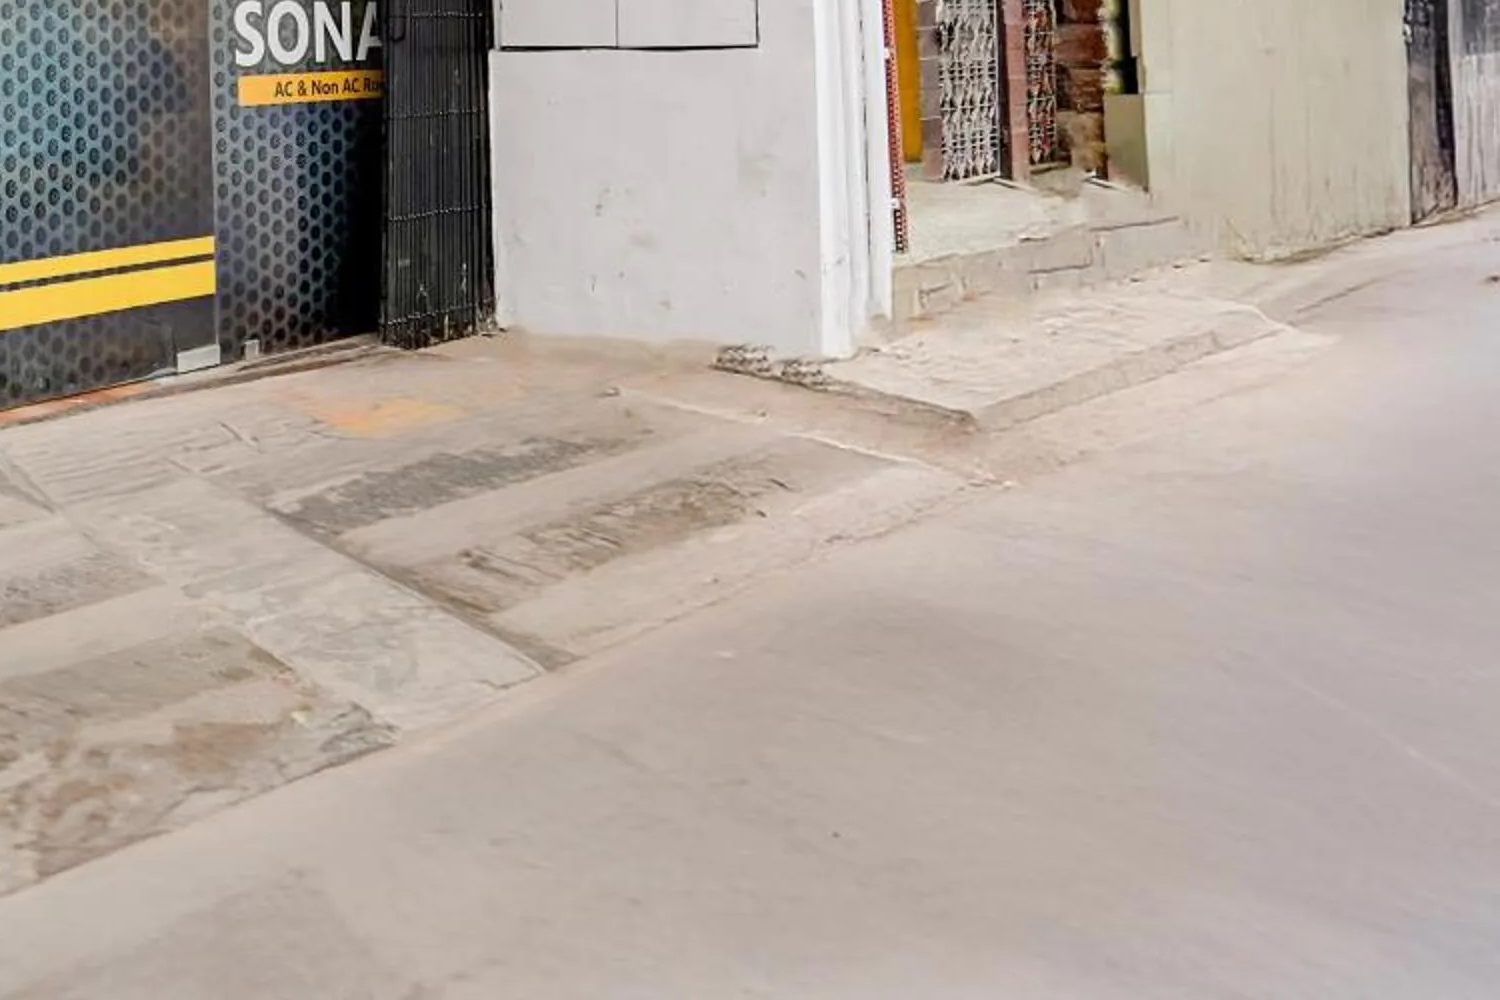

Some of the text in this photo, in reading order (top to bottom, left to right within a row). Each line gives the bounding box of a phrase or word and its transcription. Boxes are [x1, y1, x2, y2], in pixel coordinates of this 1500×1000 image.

[234, 0, 384, 67] SONA
[275, 81, 293, 97] AC
[297, 79, 307, 96] &
[312, 79, 338, 95] Non
[342, 77, 361, 93] AC
